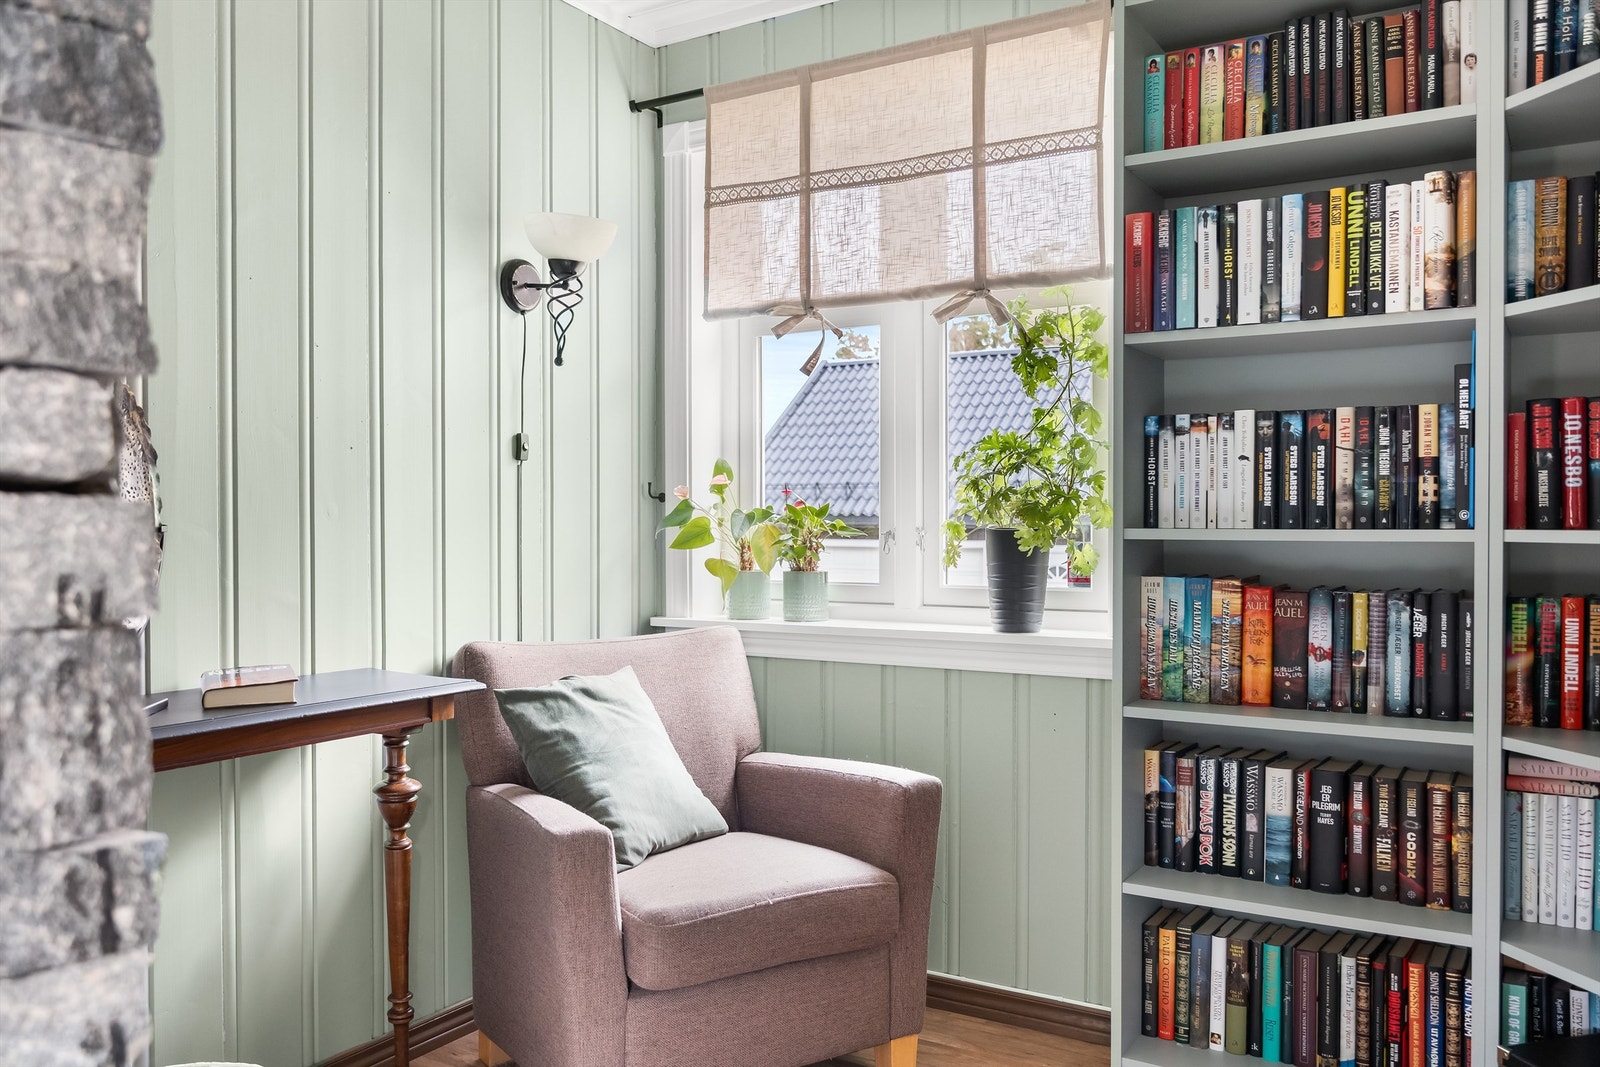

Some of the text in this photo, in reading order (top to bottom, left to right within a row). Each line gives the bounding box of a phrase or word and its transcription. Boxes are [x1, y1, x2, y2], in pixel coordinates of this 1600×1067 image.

[1370, 21, 1379, 43] ANNE
[1406, 15, 1415, 37] ANNE
[1533, 23, 1548, 52] HOLT
[1562, 16, 1573, 42] Holt
[1407, 39, 1416, 65] KARIN
[1234, 60, 1242, 103] CECILIA
[1354, 77, 1362, 106] ELSTAD
[1372, 73, 1380, 102] ELSTAD
[1408, 67, 1417, 97] ELSTAD
[1308, 203, 1322, 238] JO NESBØ
[1331, 204, 1341, 225] NESBØ
[1347, 191, 1364, 239] UNNI
[1541, 180, 1558, 228] DAN BROWN
[1158, 215, 1170, 248] LÄCKBERG
[1286, 230, 1296, 258] Colgan
[1370, 184, 1382, 291] ROHDE DET DU IKKE VET
[1349, 240, 1360, 287] LINDELL
[1388, 210, 1399, 294] KASTANJEMANNEN
[1459, 379, 1468, 388] ØL
[1459, 390, 1469, 408] HELE
[1339, 418, 1350, 444] DAHL
[1358, 419, 1369, 445] DAHL
[1459, 410, 1471, 429] ÅRET
[1401, 430, 1411, 444] Johan
[1402, 445, 1412, 462] Theorin
[1423, 417, 1432, 468] JOHAN THEORIN
[1564, 413, 1582, 487] JO NESBØ
[1379, 425, 1390, 511] JOHAN THEORIN GRAVRØYS
[1533, 404, 1552, 507] JO NESBØ PANSERHJERTE
[1289, 470, 1297, 506] LARSSON
[1316, 470, 1324, 506] LARSSON
[1245, 601, 1269, 611] AUEL
[1274, 608, 1305, 618] AUEL
[1275, 598, 1294, 607] JEAN
[1169, 598, 1178, 643] HESTENES
[1511, 603, 1528, 654] LINDELL
[1540, 604, 1556, 655] LINDELL
[1565, 618, 1579, 645] UNNI
[1145, 596, 1157, 689] HULEBJØRNENS KLAN
[1169, 646, 1178, 664] DAL
[1190, 600, 1202, 690] MAMMUTJEGERNE
[1220, 598, 1230, 692] STEPPEVANDRINGEN
[1413, 607, 1424, 678] JÆGER DOMMEN
[1564, 647, 1579, 692] LINDELL
[1521, 763, 1588, 777] SARAH JIO
[1320, 785, 1332, 794] JEG
[1321, 794, 1330, 802] ER
[1458, 792, 1470, 803] TOM
[1519, 782, 1592, 796] SARAH JIO
[1311, 801, 1340, 812] PILEGRIM
[1317, 817, 1334, 825] HAYES
[1458, 804, 1470, 827] EGELAND
[1526, 800, 1536, 838] SARAH
[1199, 790, 1213, 866] DINAS BOK
[1222, 794, 1236, 866] LYKKENS SØNN
[1376, 784, 1391, 871] TOM EGELAND FALKEN
[1406, 788, 1416, 878] TOM EGELAND CODEX
[1433, 791, 1446, 893] TOM EGELAND PAKTENS VOKTERE
[1561, 804, 1571, 861] SARAH JIO
[1578, 809, 1592, 860] SARAH
[1525, 842, 1536, 859] JIO
[1458, 864, 1470, 896] EVANGELIUM
[1578, 866, 1592, 890] JIO
[1161, 935, 1170, 1028] PAULO COELHO Zahir
[1409, 967, 1422, 1018] Prinsessen
[1388, 990, 1401, 1042] DØDSRANET.
[1430, 971, 1439, 1047] SIDNEY SHELDON UT AV
[1509, 995, 1520, 1029] KIND OF
[1265, 1019, 1276, 1042] REISEN
